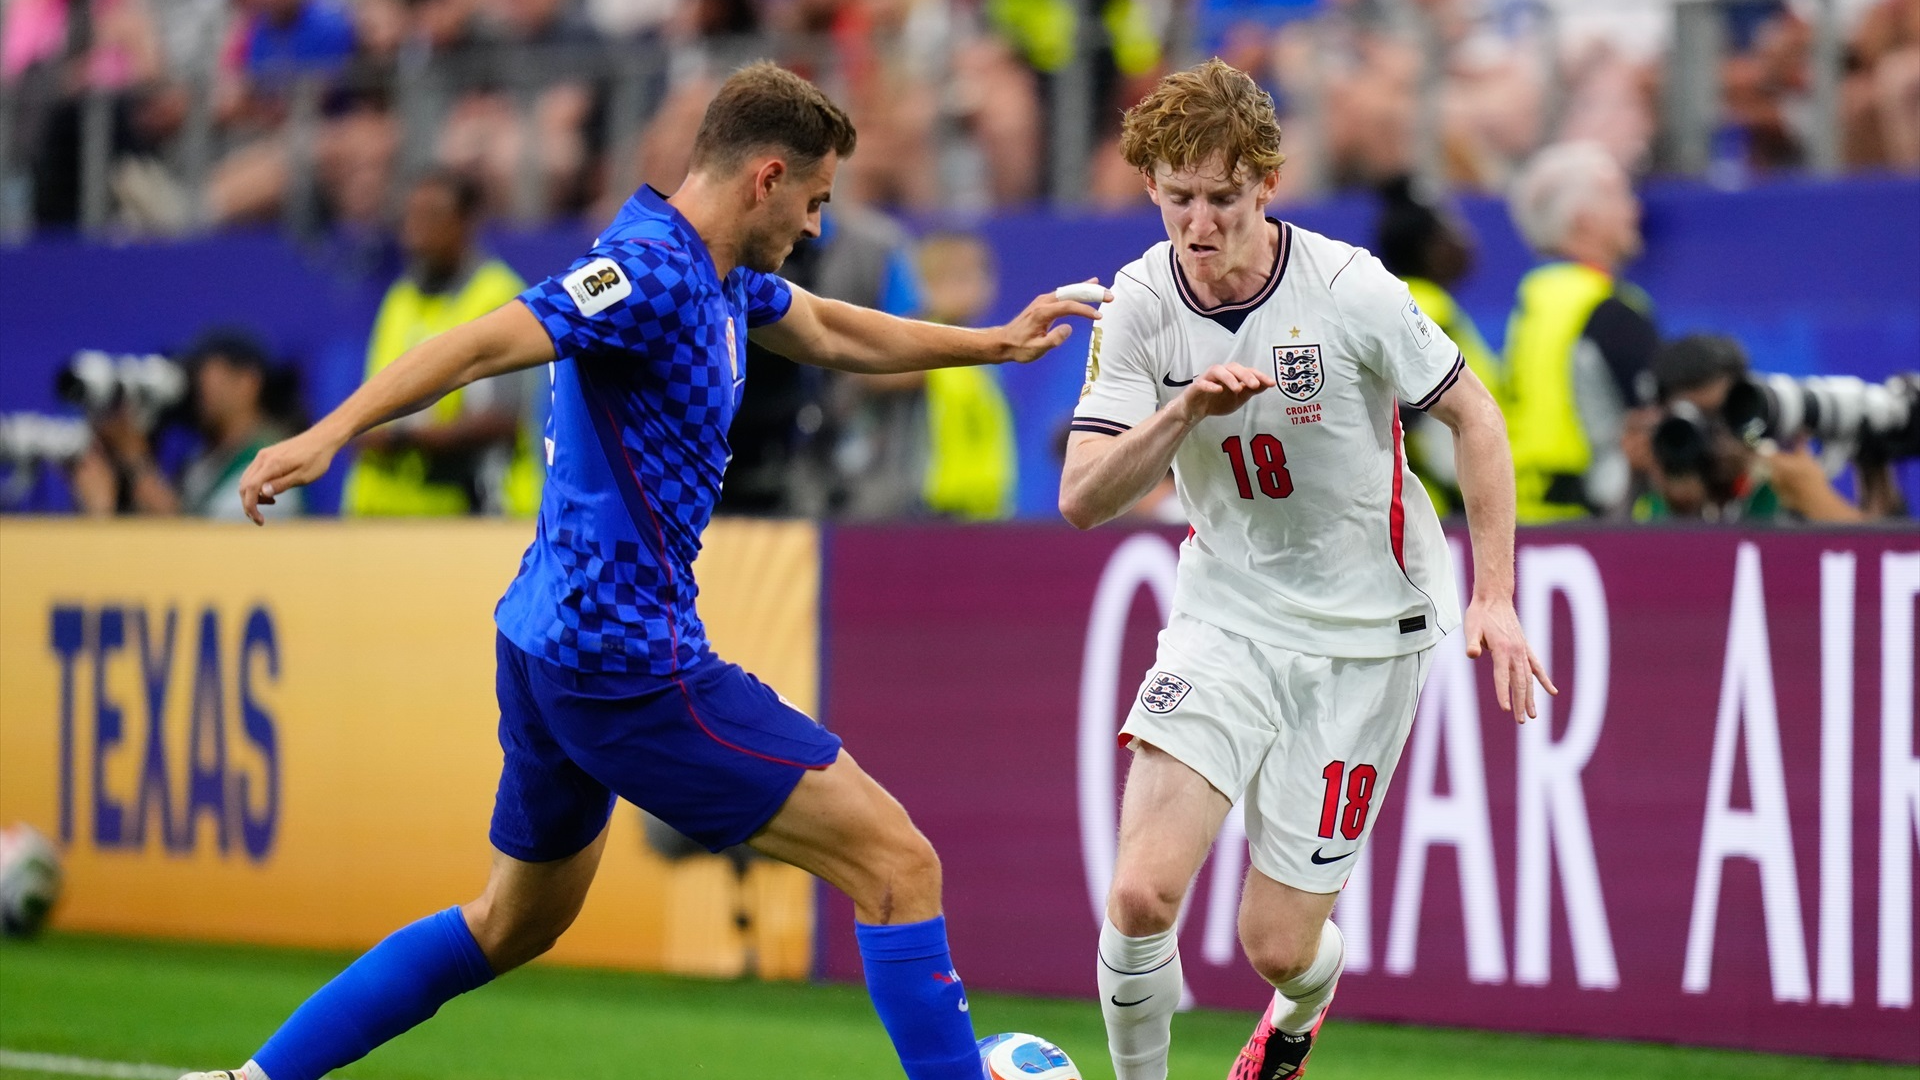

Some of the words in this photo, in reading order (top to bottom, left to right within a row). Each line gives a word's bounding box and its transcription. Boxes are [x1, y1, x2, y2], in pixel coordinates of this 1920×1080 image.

[1286, 403, 1322, 415] CROATIA
[1291, 413, 1321, 425] 17.06.26
[1221, 434, 1294, 499] 18
[49, 602, 281, 863] TEXAS
[1077, 533, 1620, 1010] QAR
[1318, 760, 1377, 840] 18
